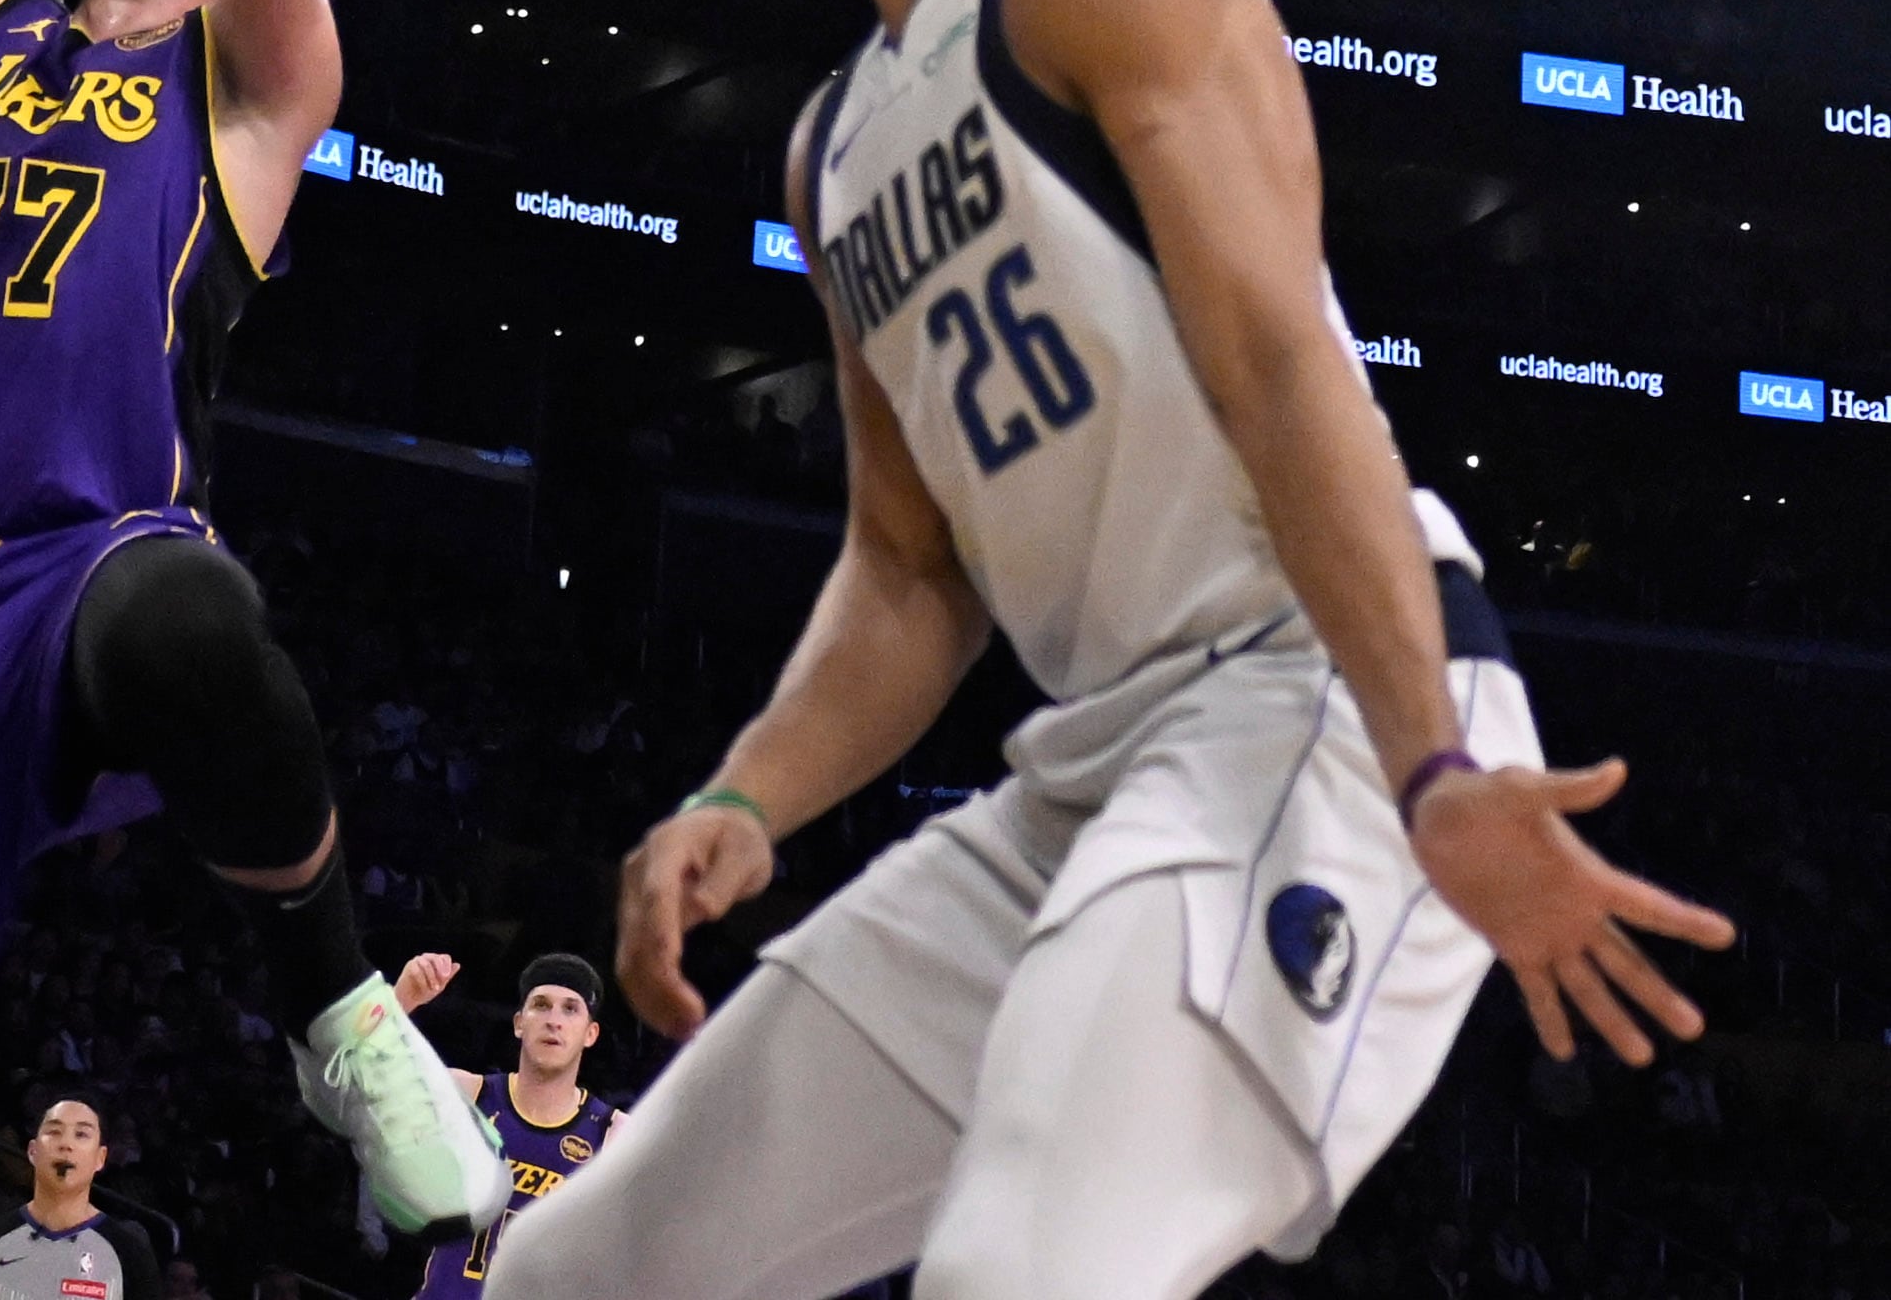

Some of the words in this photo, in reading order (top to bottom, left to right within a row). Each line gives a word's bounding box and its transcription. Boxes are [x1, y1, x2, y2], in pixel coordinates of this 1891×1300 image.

[1536, 67, 1612, 101] UCLA
[1632, 75, 1745, 122] Health
[357, 145, 444, 196] Health
[515, 191, 678, 244] uclahealth.org
[925, 241, 1097, 477] 26
[1500, 353, 1664, 398] uclahealth.org
[1751, 382, 1814, 411] UCLA
